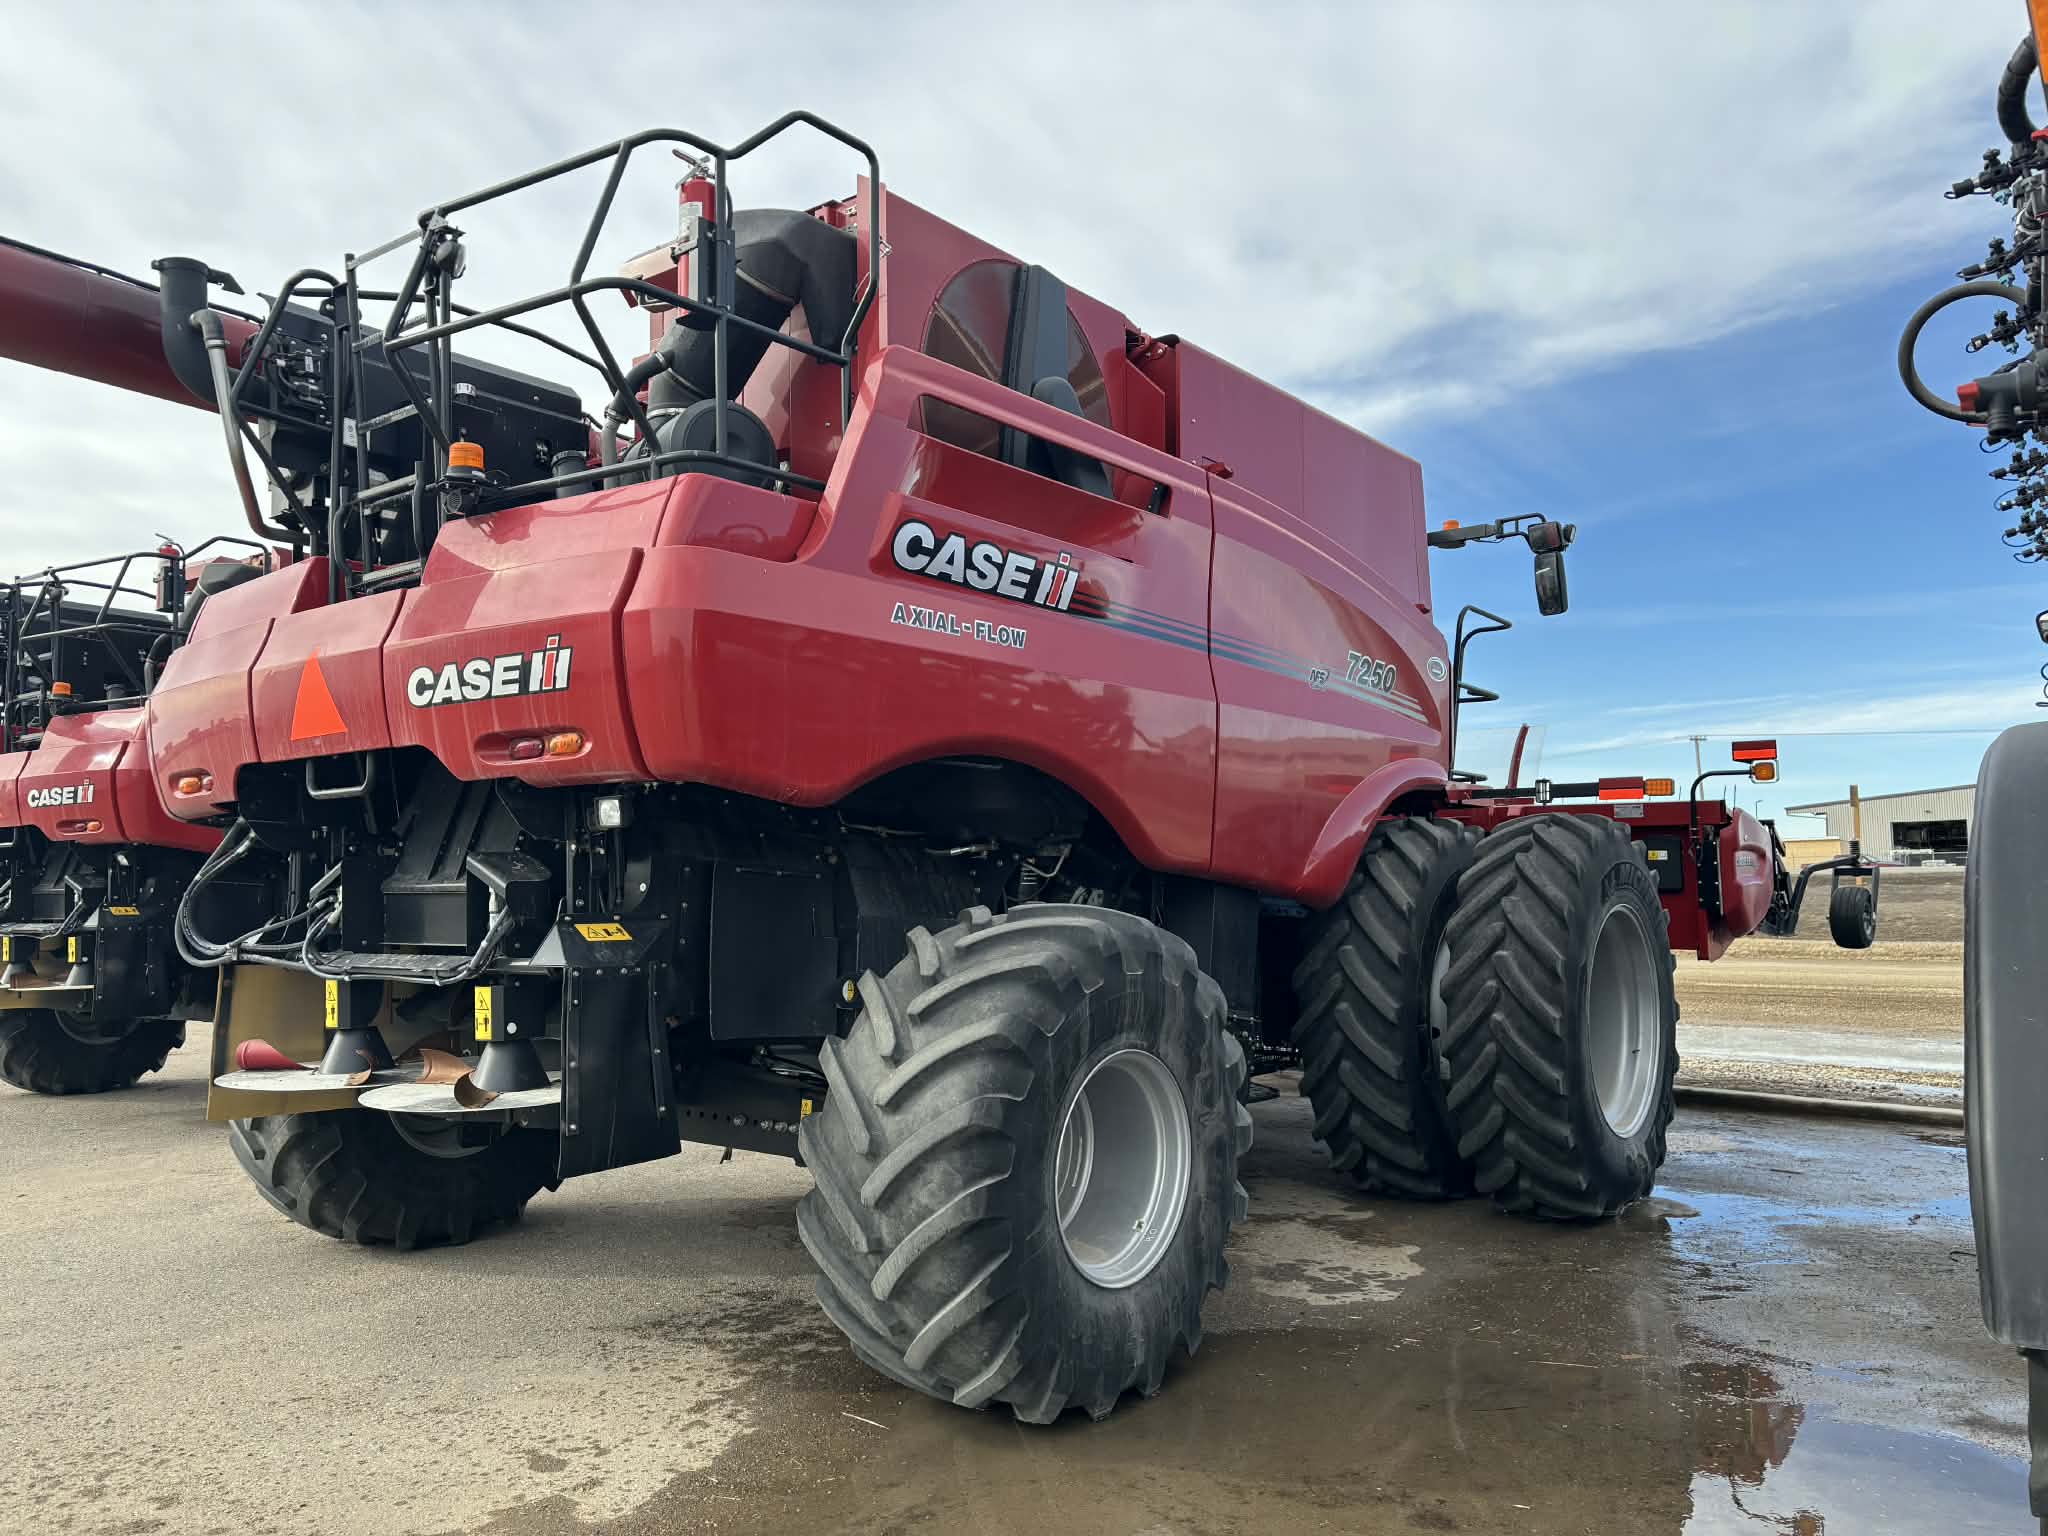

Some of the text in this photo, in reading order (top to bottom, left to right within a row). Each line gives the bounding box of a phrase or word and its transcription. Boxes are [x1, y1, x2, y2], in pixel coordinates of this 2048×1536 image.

[893, 521, 1037, 599] CASE
[407, 654, 523, 707] CASE
[1345, 650, 1397, 693] 7250
[27, 786, 75, 808] CASE
